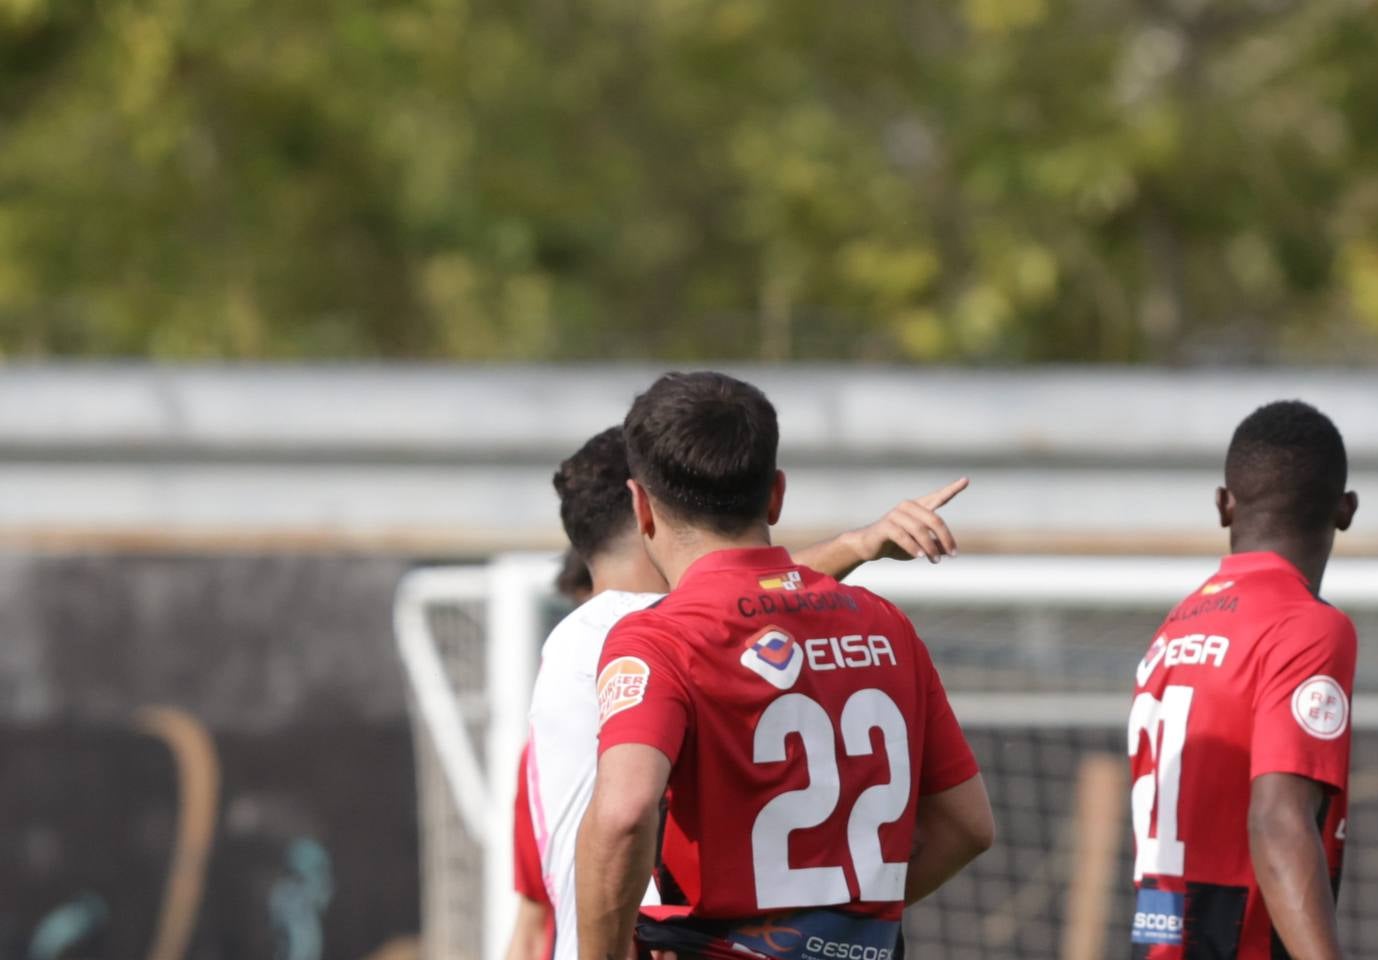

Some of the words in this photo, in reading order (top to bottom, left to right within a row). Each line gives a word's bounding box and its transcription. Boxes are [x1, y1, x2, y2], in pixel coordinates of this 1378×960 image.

[807, 633, 898, 671] EISA
[751, 687, 913, 910] 22
[1128, 684, 1194, 882] 21
